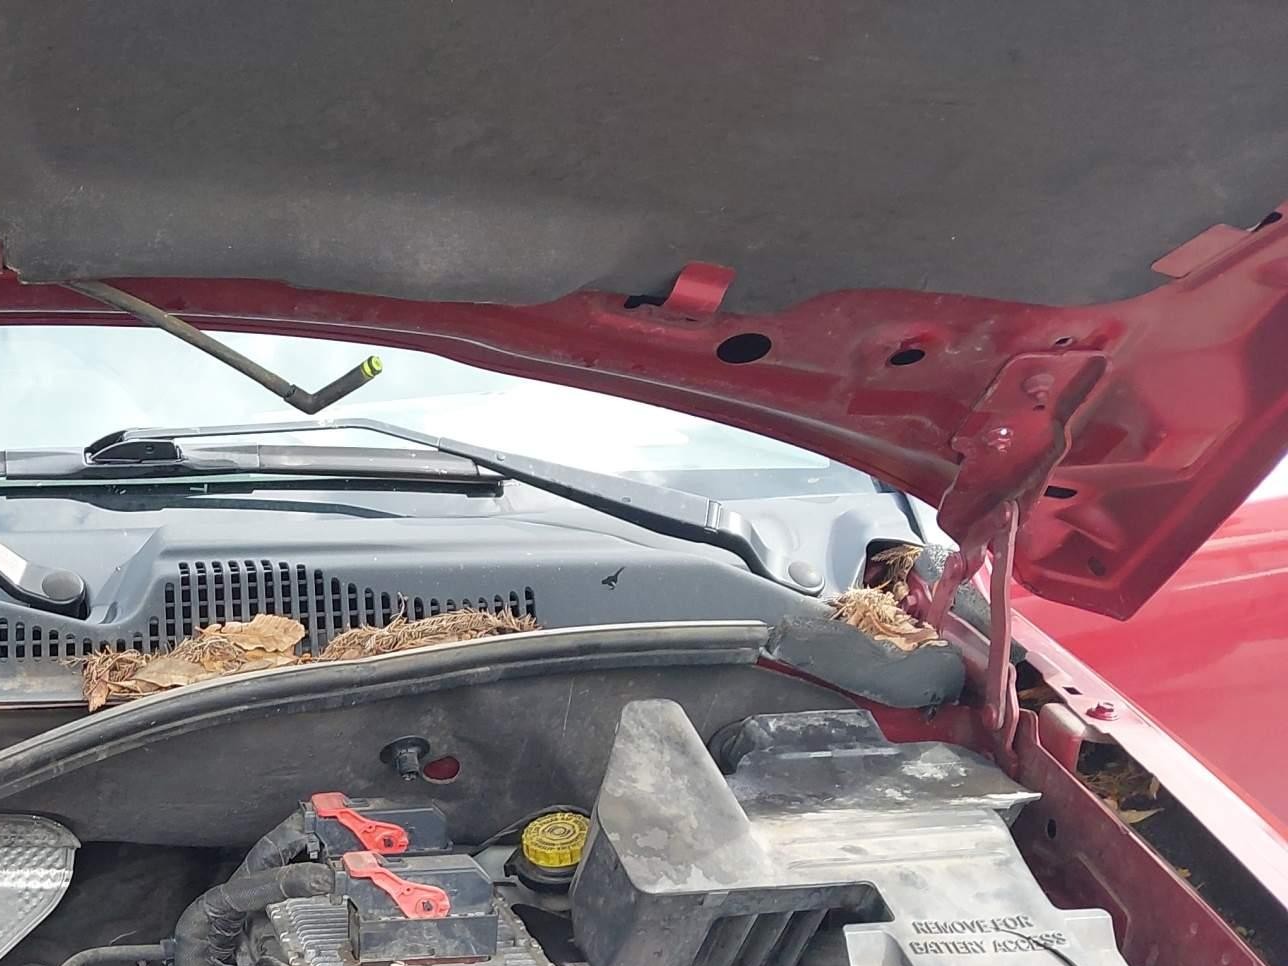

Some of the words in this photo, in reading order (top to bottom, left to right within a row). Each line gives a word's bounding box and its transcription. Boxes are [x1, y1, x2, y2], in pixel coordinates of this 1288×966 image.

[912, 920, 990, 934] REMOVE
[992, 915, 1034, 931] FOR
[909, 940, 987, 954] BATTERY
[993, 932, 1067, 953] ACCESS
